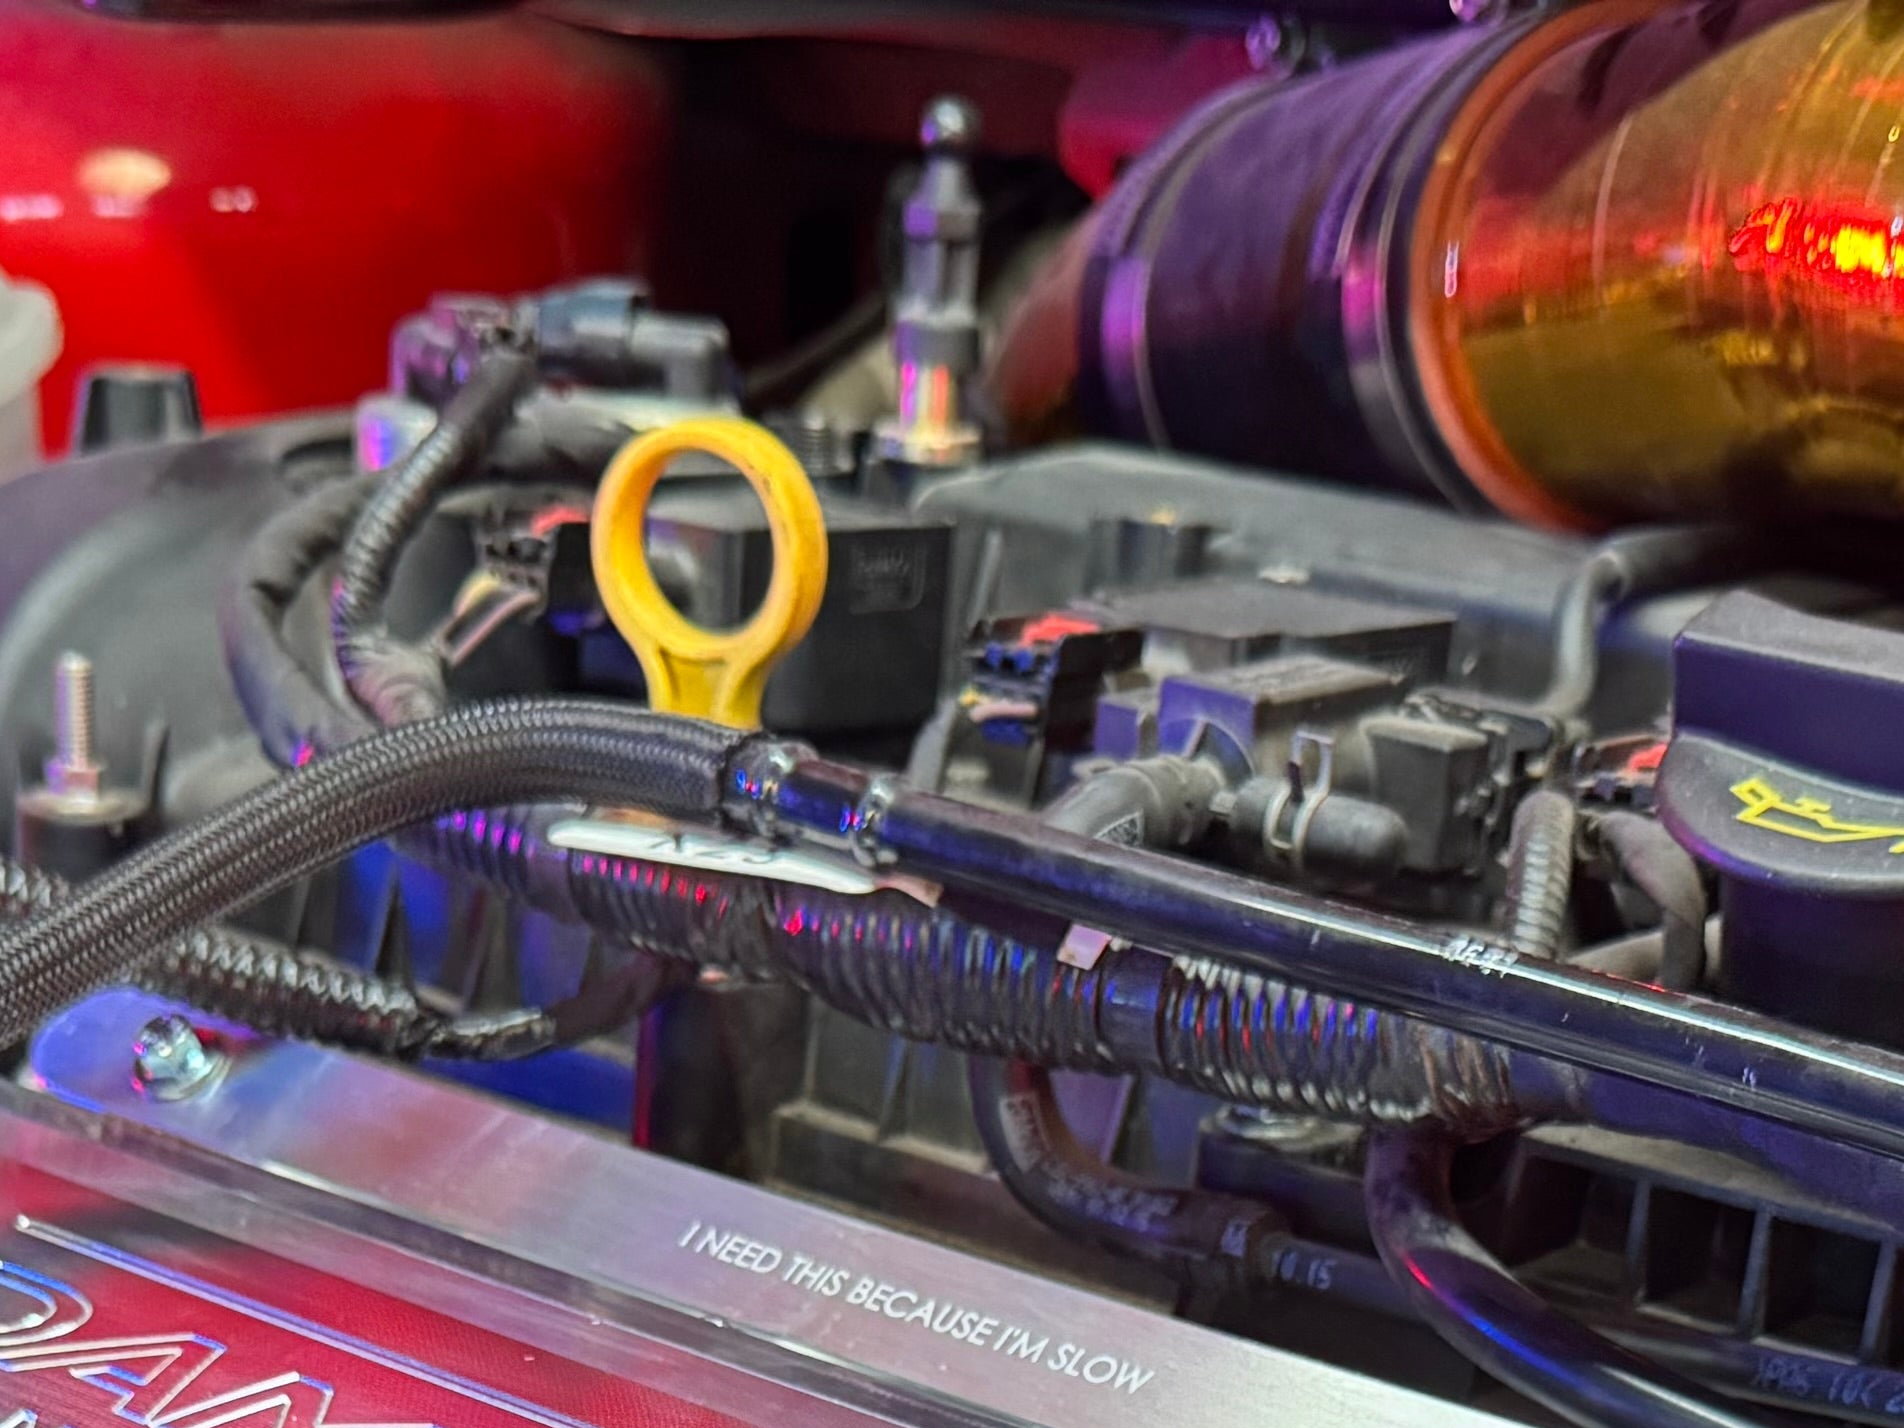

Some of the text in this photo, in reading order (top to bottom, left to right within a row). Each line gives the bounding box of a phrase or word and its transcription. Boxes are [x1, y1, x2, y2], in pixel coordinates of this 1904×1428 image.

[679, 1220, 1156, 1395] I NEED THIS BECAUSE I'M SLOW
